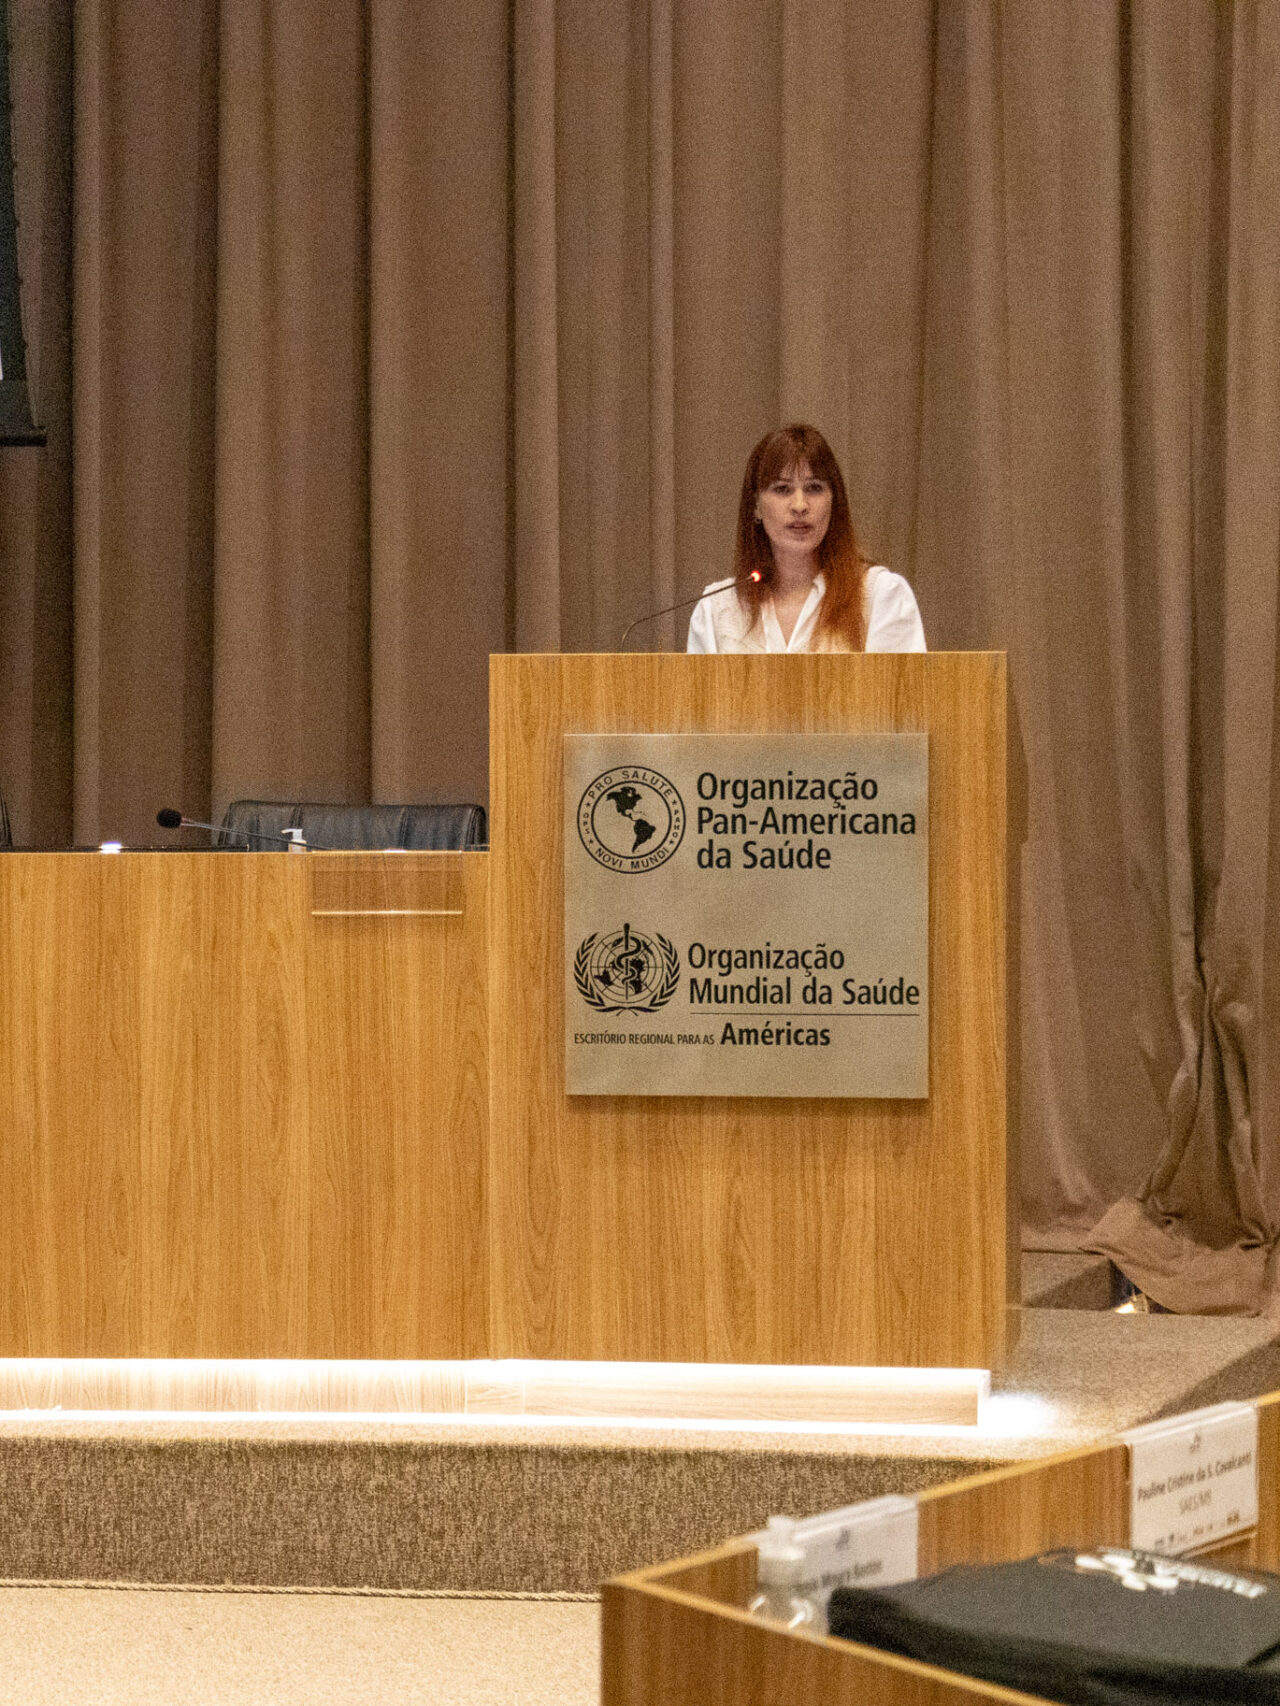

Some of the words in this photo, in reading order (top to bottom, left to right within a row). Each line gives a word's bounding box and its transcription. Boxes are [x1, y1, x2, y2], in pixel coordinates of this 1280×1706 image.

[588, 776, 613, 800] PRO
[621, 770, 673, 798] SALUTE
[696, 770, 879, 809] Organização
[697, 804, 917, 835] Pan-Americana
[595, 847, 623, 869] NOVI
[630, 846, 670, 870] MUNDI
[696, 838, 731, 870] da
[742, 838, 832, 870] Saúde
[687, 942, 845, 977] Organização
[689, 976, 792, 1005] Mundial
[802, 976, 833, 1005] da
[842, 976, 920, 1006] Saúde
[574, 1030, 627, 1044] ESCRITÓRIO
[628, 1033, 675, 1045] REGIONAL
[677, 1034, 701, 1045] PARA
[702, 1034, 715, 1045] AS
[720, 1021, 831, 1046] Américas
